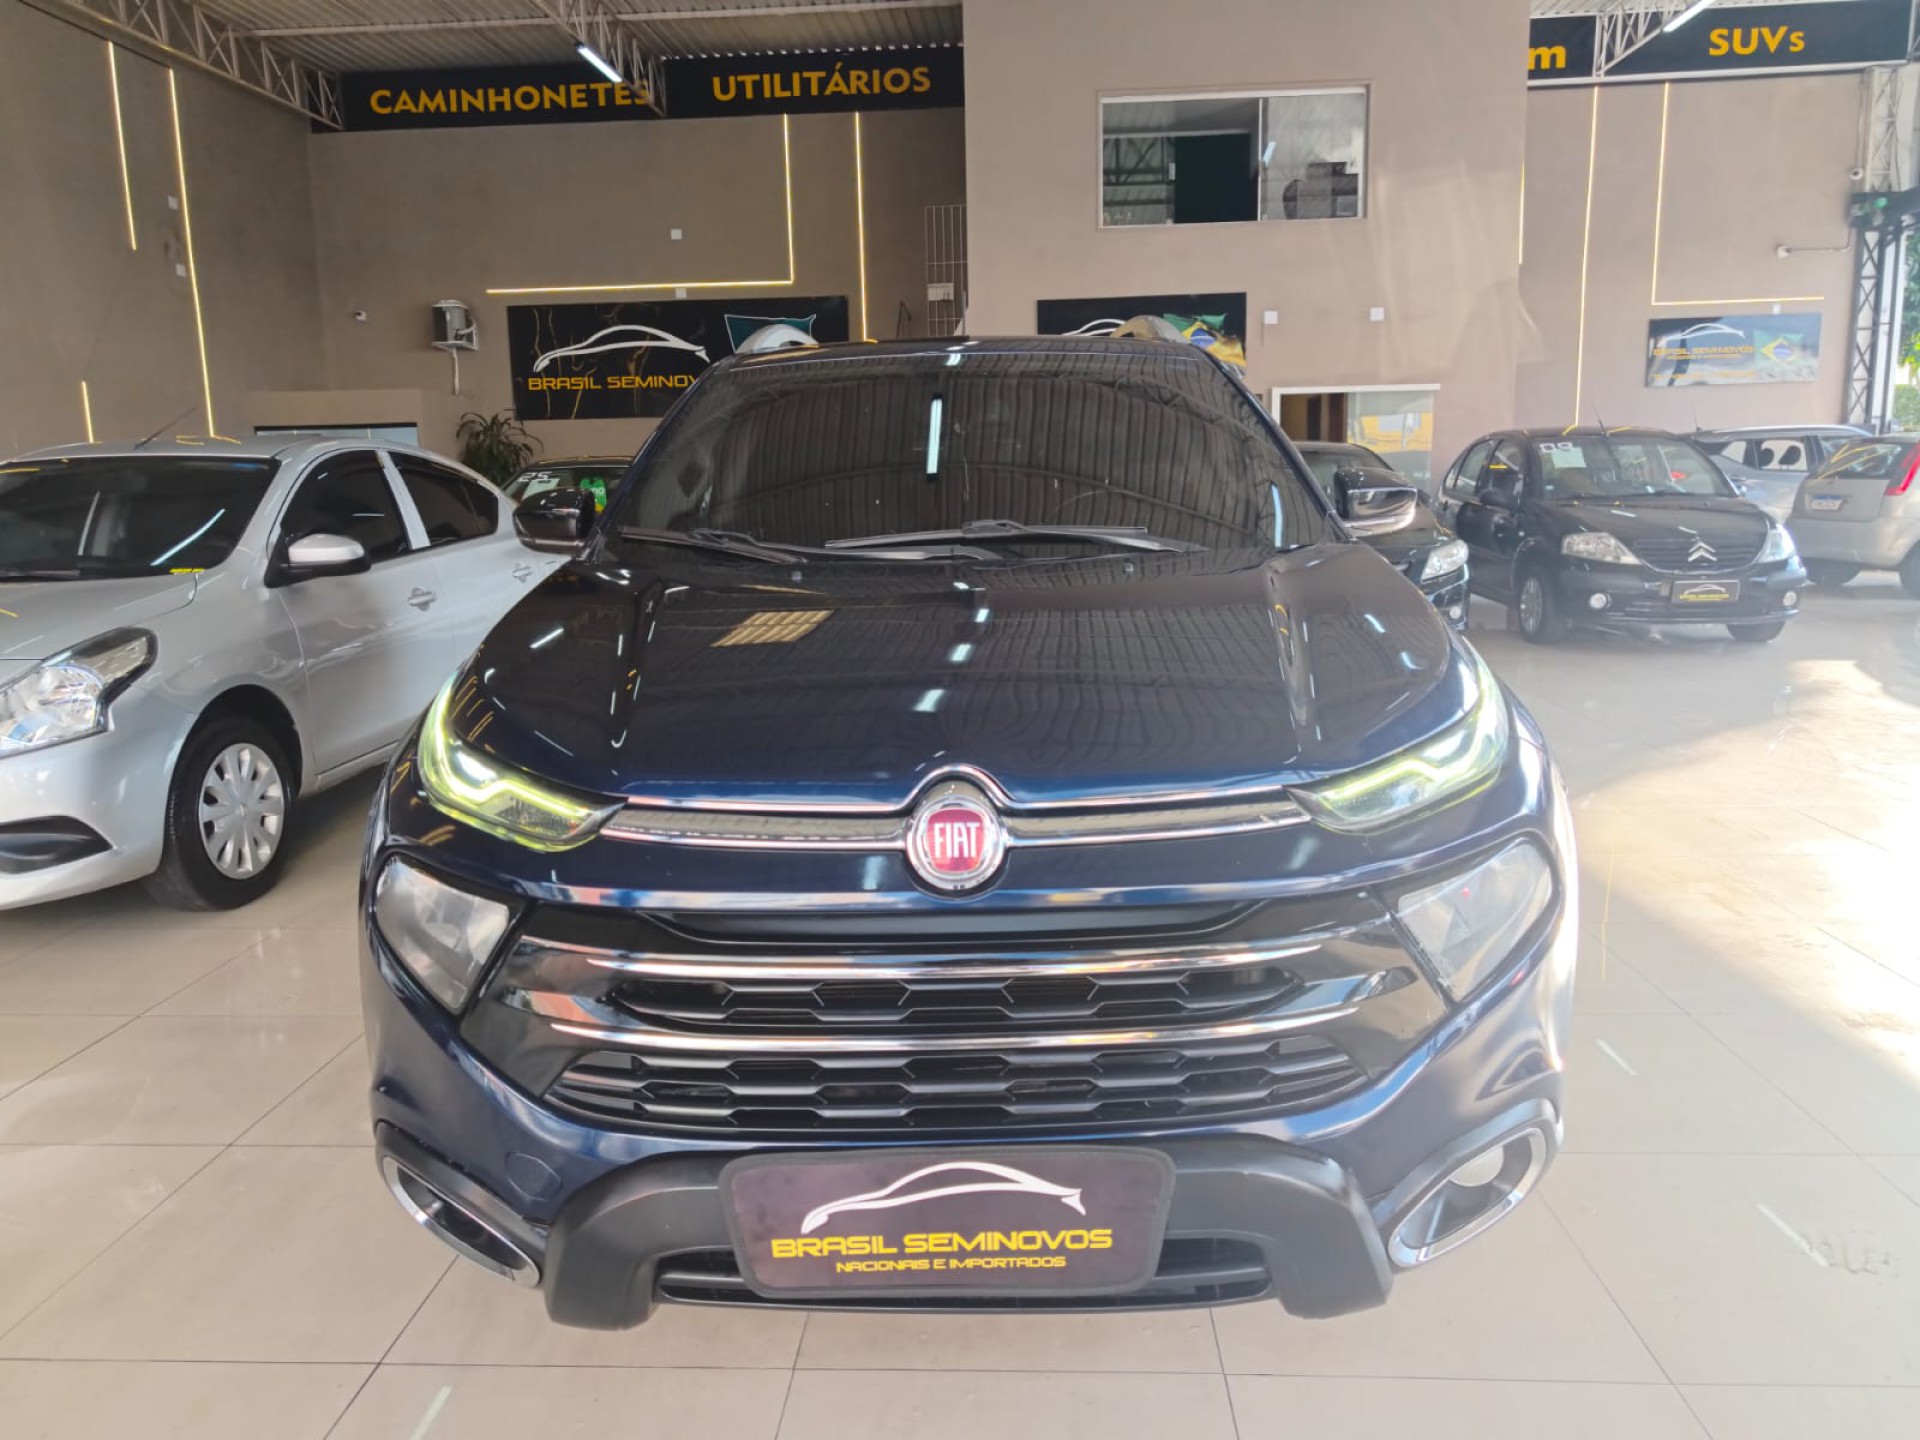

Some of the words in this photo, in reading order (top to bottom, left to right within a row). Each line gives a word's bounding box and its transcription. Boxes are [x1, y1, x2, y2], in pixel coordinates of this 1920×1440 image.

[1709, 26, 1805, 56] SUVs
[712, 61, 931, 101] UTILITÁRIOS
[370, 79, 650, 115] CAMINHONETES
[528, 376, 602, 391] BRASIL
[933, 822, 980, 858] FIAT
[771, 1235, 898, 1258] BRASIL
[903, 1229, 1113, 1254] SEMINOVOS
[836, 1259, 930, 1273] NACIONAIS
[933, 1259, 946, 1270] E
[949, 1256, 1067, 1269] IMPORTADOS
